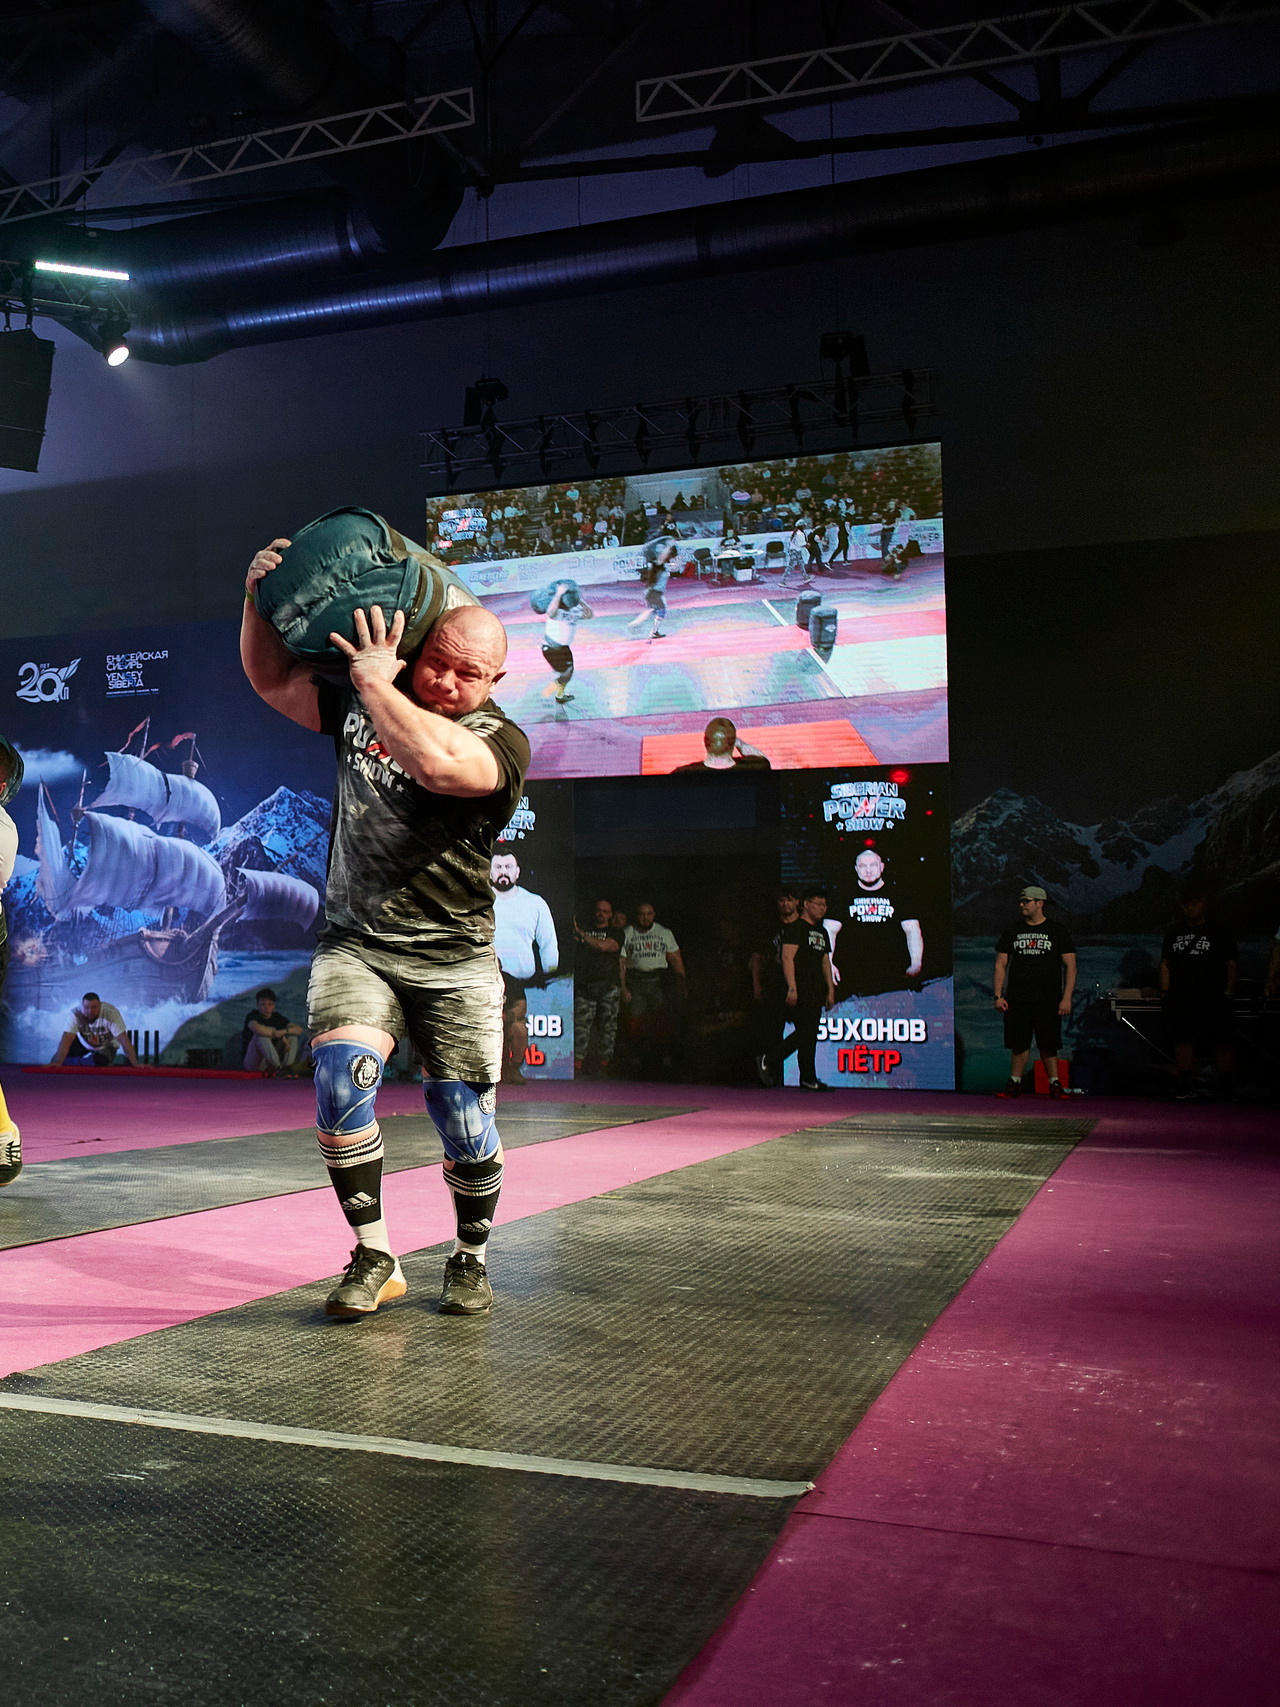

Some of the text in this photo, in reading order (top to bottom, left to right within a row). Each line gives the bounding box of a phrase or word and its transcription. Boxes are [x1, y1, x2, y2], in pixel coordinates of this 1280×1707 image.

[106, 650, 169, 663] ЕНИСЕЙСКАЯ
[106, 660, 143, 671] СИБИРЬ
[106, 670, 144, 681] YENISEY
[108, 679, 144, 689] SIBERIA
[353, 752, 395, 789] SHOW
[830, 782, 898, 799] SIBERIAN
[822, 797, 907, 822] POWER
[844, 819, 885, 832] SHOW
[849, 904, 894, 918] POWER
[1013, 939, 1052, 950] POWER
[837, 1044, 901, 1073] ПЁТР
